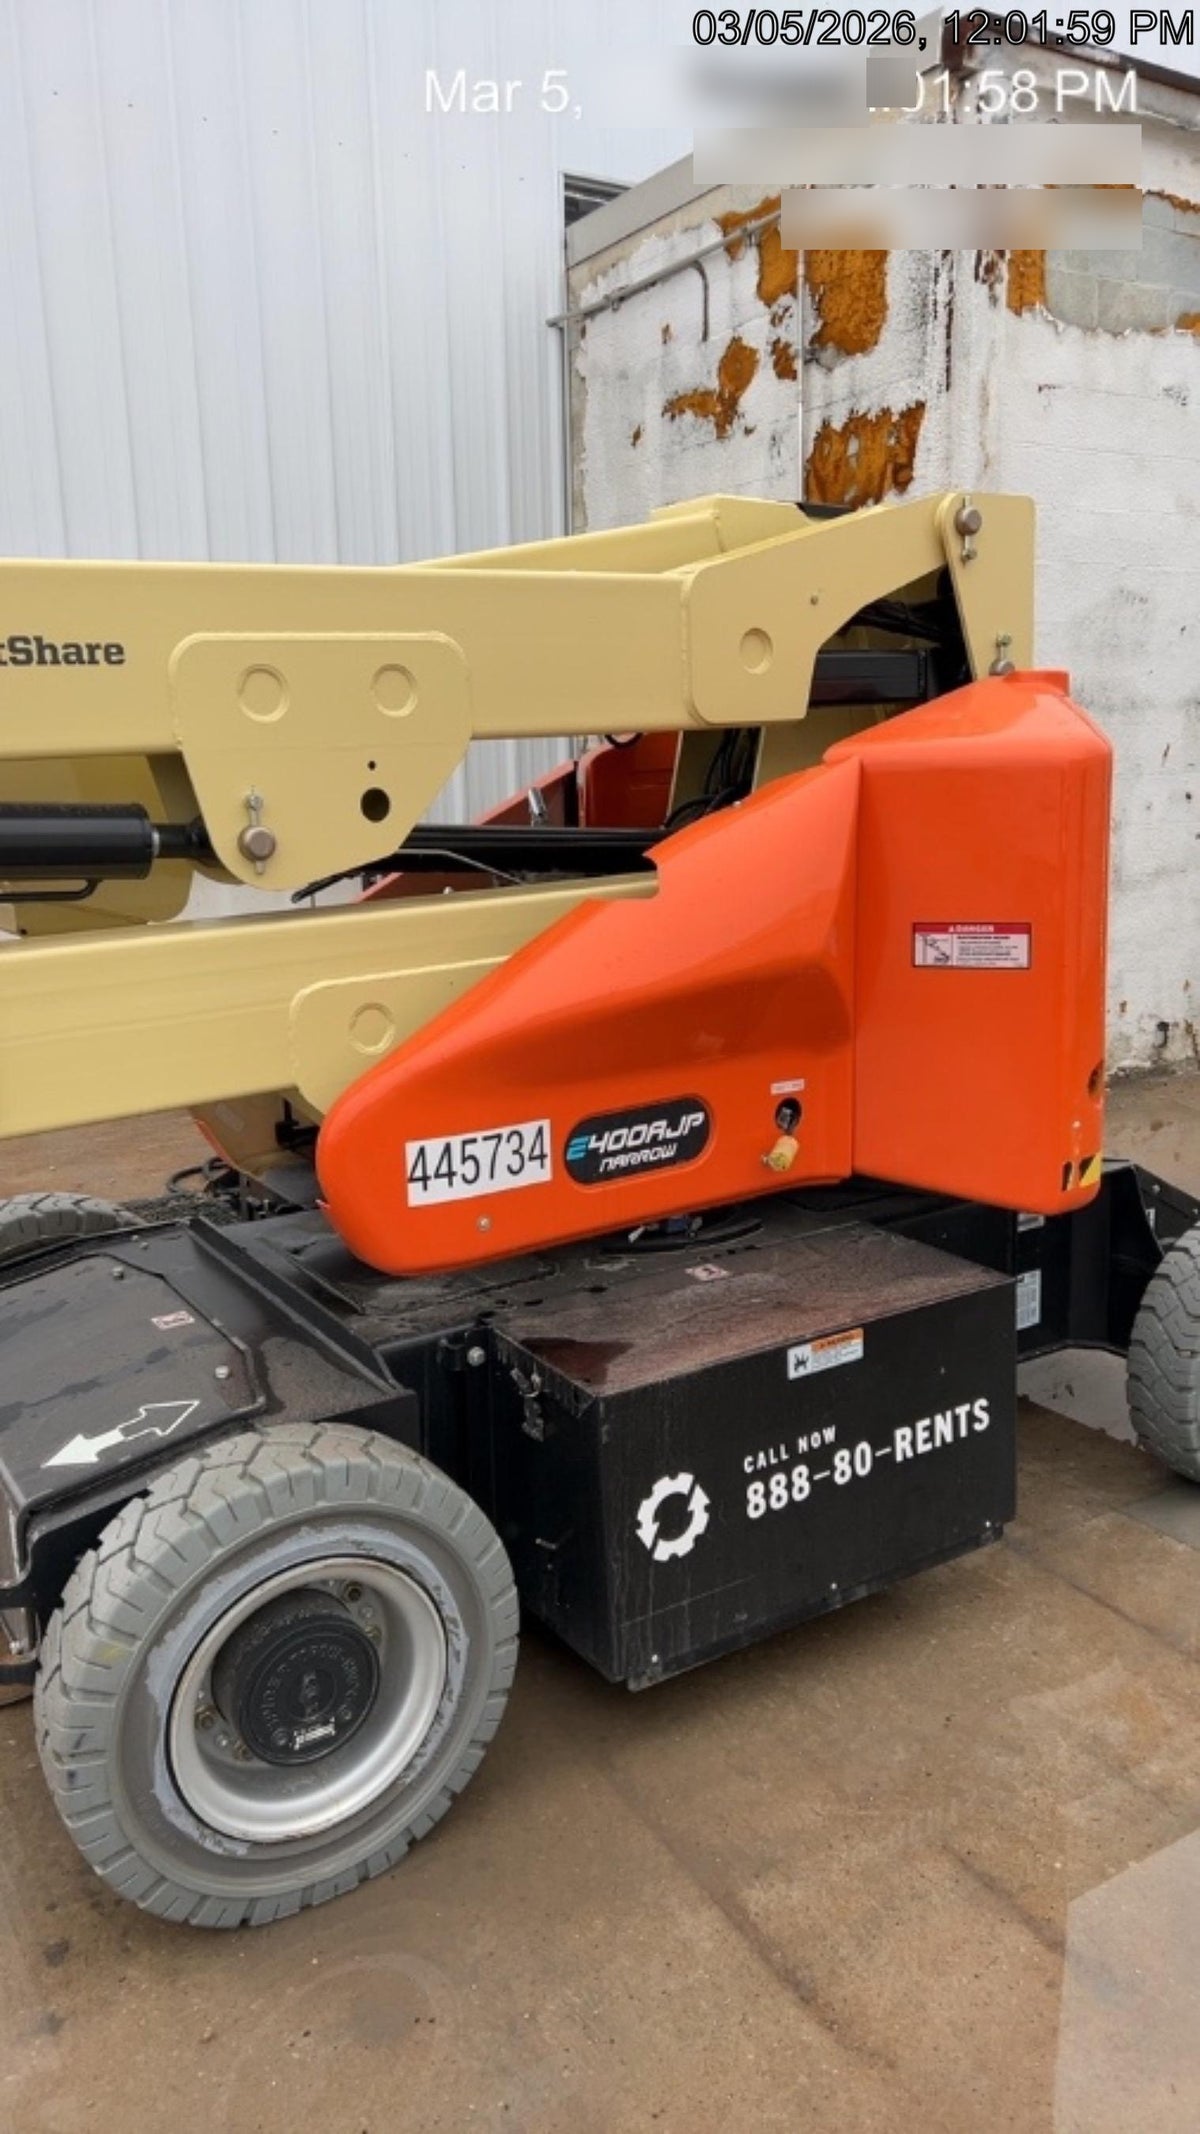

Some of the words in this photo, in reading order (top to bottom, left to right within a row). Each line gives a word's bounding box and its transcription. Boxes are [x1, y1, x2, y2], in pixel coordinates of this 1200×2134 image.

[408, 1125, 548, 1191] 445734
[600, 1143, 678, 1173] NARROW
[744, 1444, 789, 1474] CALL
[798, 1424, 837, 1454] NOW
[746, 1397, 991, 1519] 888-80-RENTS
